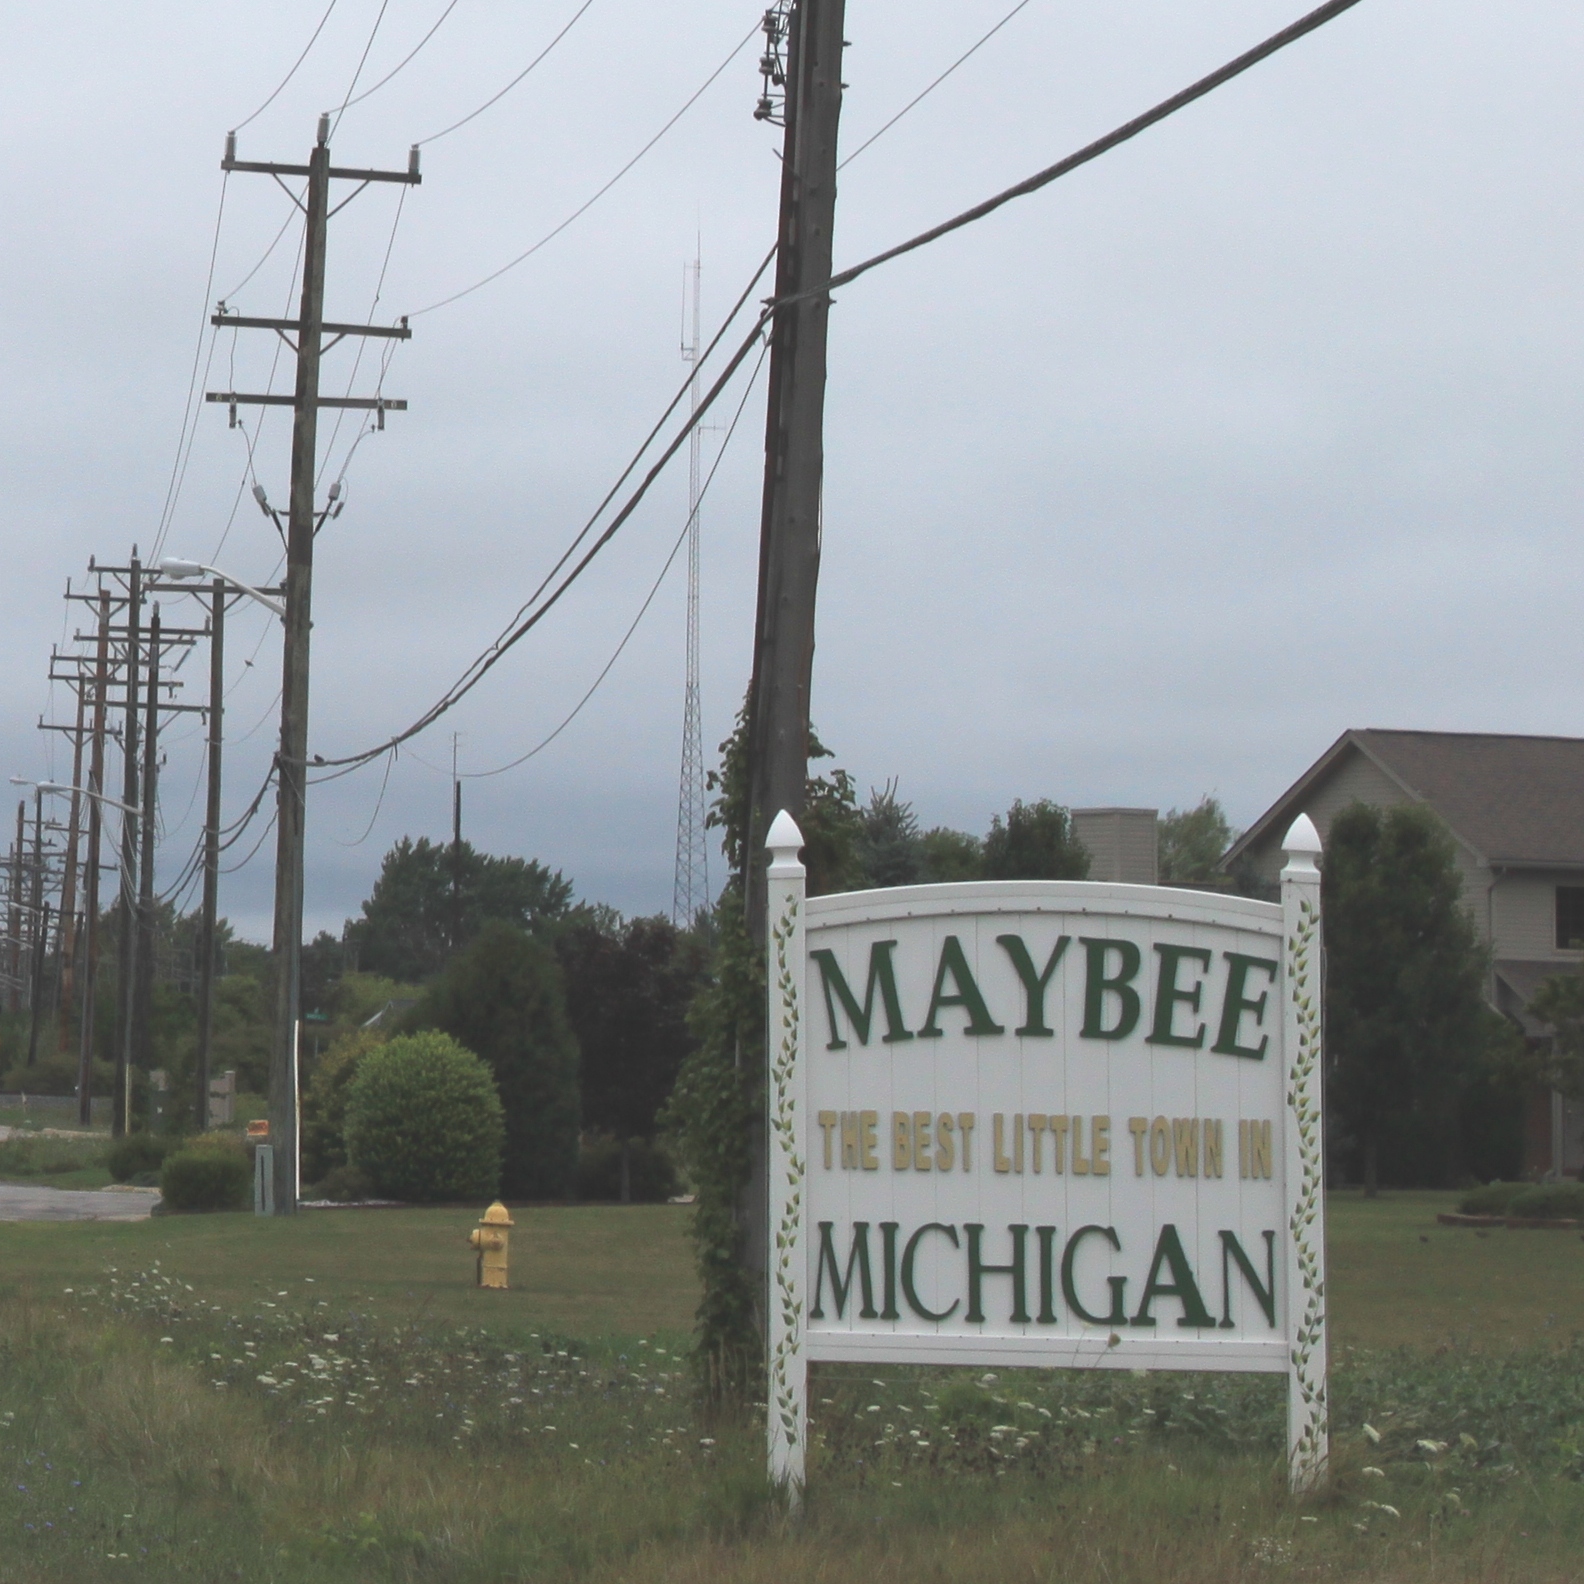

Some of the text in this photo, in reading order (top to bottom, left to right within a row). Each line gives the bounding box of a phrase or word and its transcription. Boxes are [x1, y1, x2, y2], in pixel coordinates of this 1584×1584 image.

[809, 934, 1278, 1060] MAYBEE
[818, 1110, 1273, 1179] THE BEST LITTLE TOWN IN
[809, 1221, 1277, 1329] MICHIGAN
